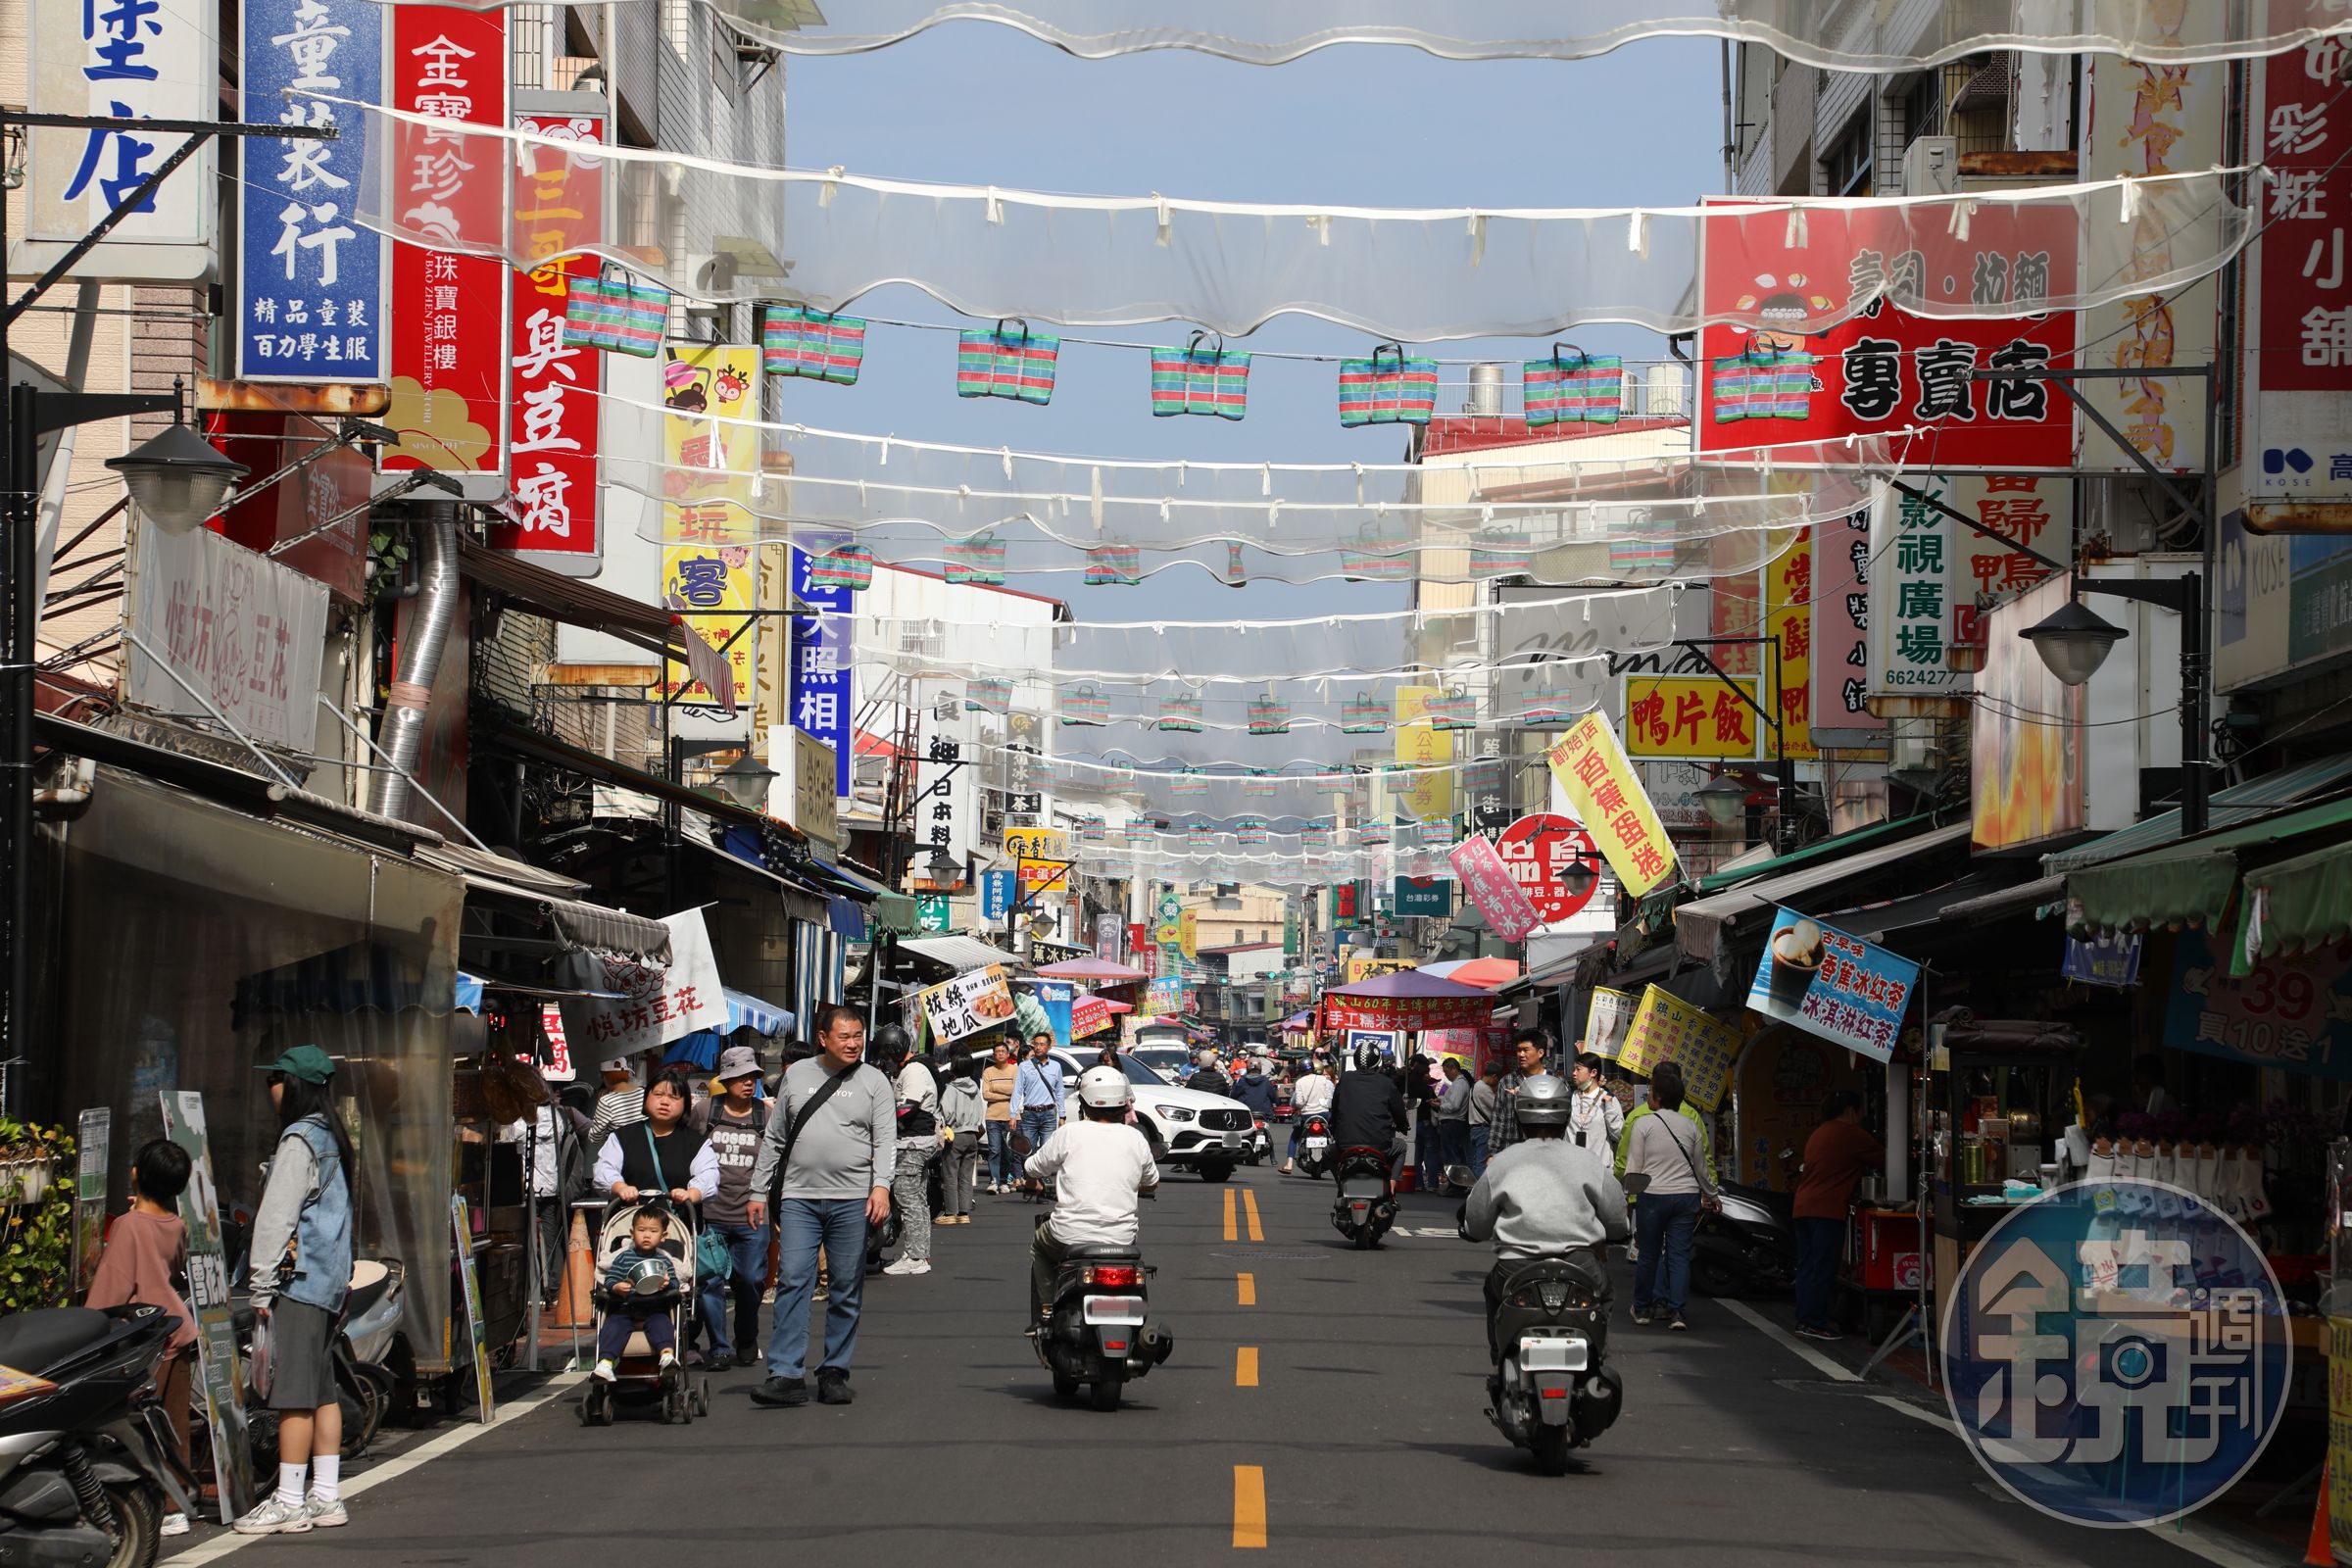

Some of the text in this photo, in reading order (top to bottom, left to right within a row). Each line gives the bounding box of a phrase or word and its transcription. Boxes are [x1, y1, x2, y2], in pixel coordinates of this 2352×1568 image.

[270, 0, 356, 286] 童裝行
[402, 33, 476, 200] 金寶珍
[254, 297, 368, 327] 精品童裝
[423, 286, 433, 318] ZHEN
[432, 255, 458, 370] 珠寶銀樓
[253, 332, 370, 362] 百力學生服
[422, 320, 433, 387] JEWELLERY
[1841, 336, 2051, 421] 專賣店
[1886, 669, 1958, 686] 6624277
[1551, 719, 1599, 767] 創始店
[1631, 689, 1753, 747] 鴨片飯
[1572, 748, 1667, 882] 香蕉蛋捲
[991, 871, 1004, 920] 南無阿彌陀佛
[1033, 944, 1091, 963] 蕉冰紅
[1822, 930, 1866, 957] 古早味
[1819, 952, 1908, 1011] 香蕉冰紅茶
[2241, 965, 2314, 1020] 39
[942, 1008, 982, 1039] 地瓜
[1654, 1001, 1729, 1047] 旗山香蕉冰
[1801, 993, 1895, 1050] 冰淇淋紅茶
[2195, 1010, 2333, 1066] 買10送1
